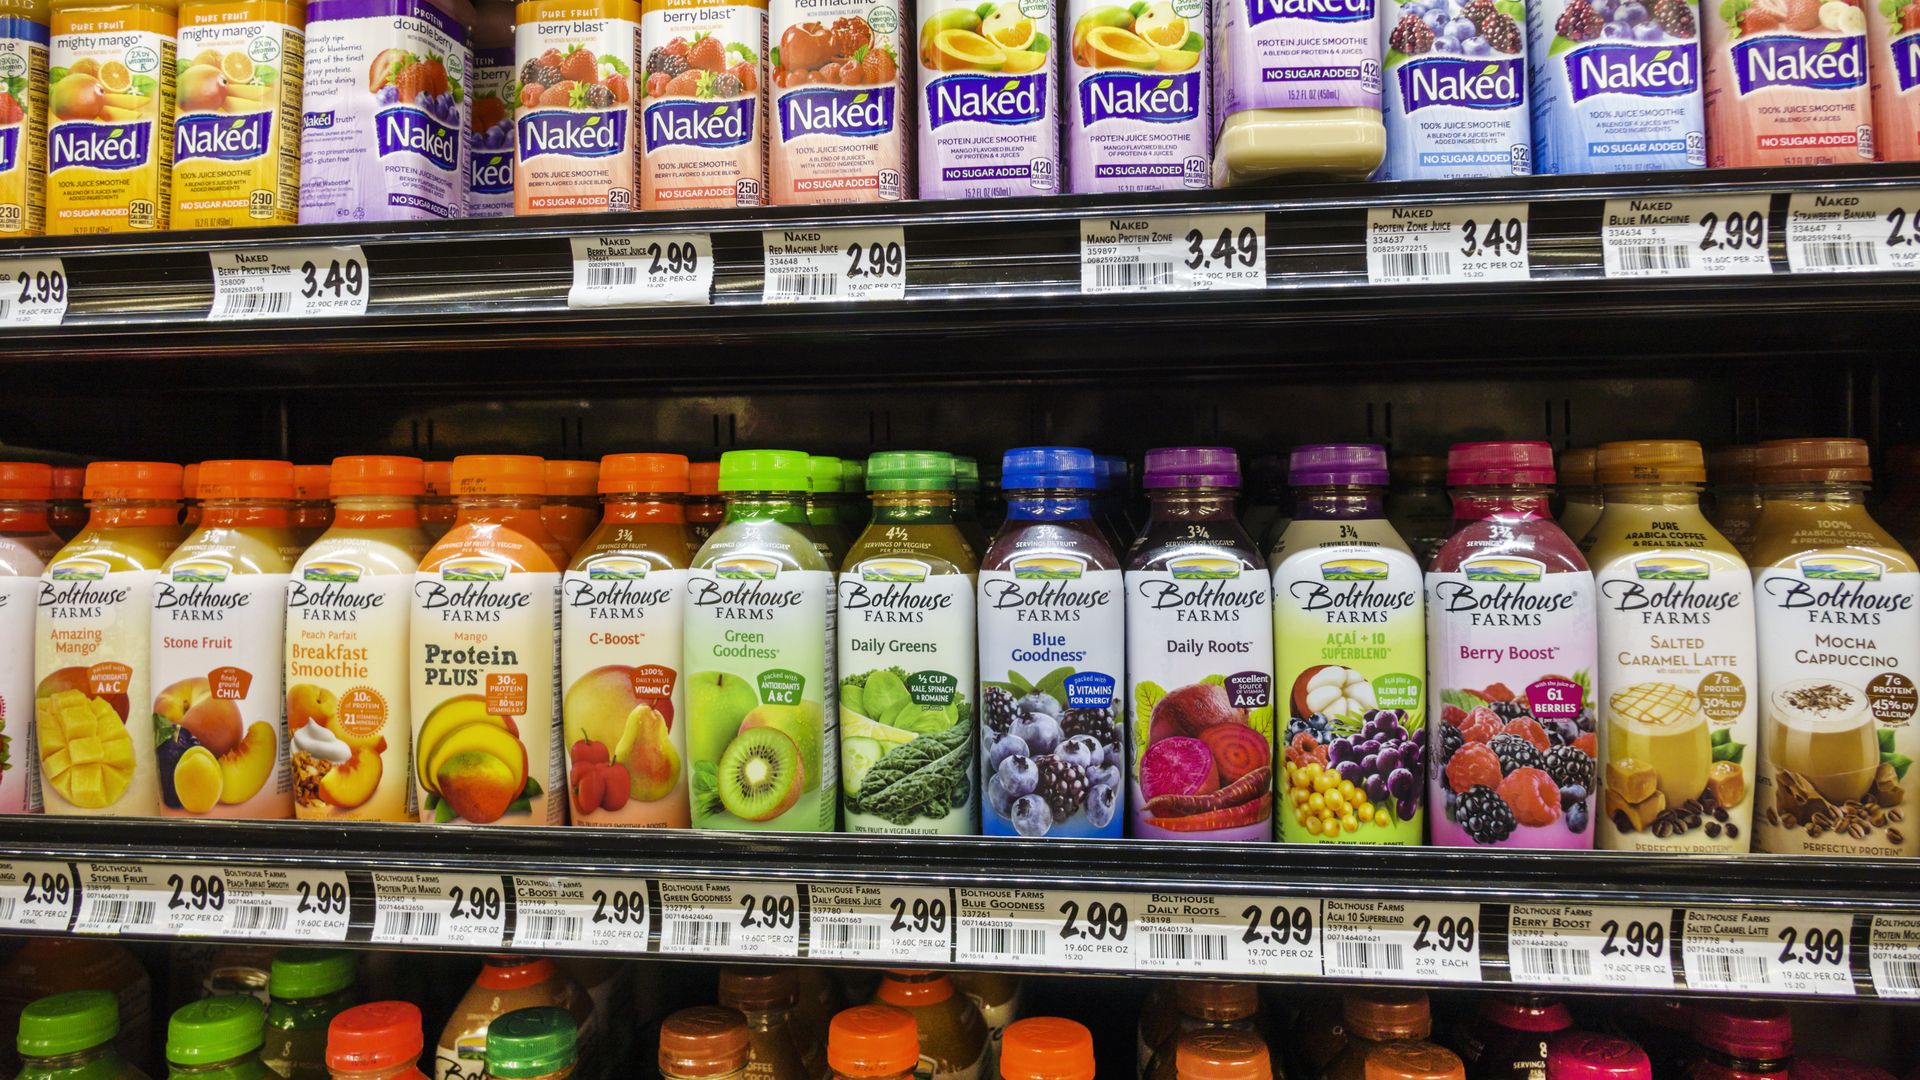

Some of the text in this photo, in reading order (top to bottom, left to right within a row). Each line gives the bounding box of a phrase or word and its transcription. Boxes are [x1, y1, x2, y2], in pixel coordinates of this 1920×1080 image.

[663, 7, 731, 23] berry blast
[182, 26, 217, 41] mighty
[538, 21, 604, 36] berry blast
[1322, 37, 1368, 46] SMOOTHIE
[1284, 71, 1320, 79] SUGAR
[1322, 70, 1360, 78] ADDED
[1032, 161, 1051, 175] 420
[880, 173, 899, 186] 320
[738, 182, 758, 195] 250
[251, 193, 272, 206] 290
[1630, 201, 1672, 211] NAKED
[1815, 196, 1859, 207] NAKED
[59, 208, 128, 219] NO SUGAR ADDED
[131, 202, 153, 215] 290
[1392, 208, 1433, 218] NAKED
[1844, 210, 1876, 220] BANANA
[1110, 220, 1149, 230] NAKED
[1609, 214, 1690, 226] BLUE MACHINE
[1373, 221, 1451, 233] PROTEIN ZONE JUICE
[1700, 211, 1763, 250] 2.99
[600, 238, 630, 246] NAKED
[784, 232, 820, 241] NAKED
[1086, 232, 1173, 243] MANGO PROTEIN ZONE
[1461, 218, 1522, 257] 3.49
[769, 244, 838, 255] RED MACHINE JUICE
[1087, 247, 1117, 255] 359897
[1184, 227, 1258, 270] 3.49
[235, 254, 268, 263] NAKED
[648, 242, 697, 275] 2.99
[846, 242, 900, 277] 2.99
[301, 259, 362, 299] 3.49
[18, 271, 65, 304] 2.99
[1652, 522, 1679, 530] PURE
[172, 609, 223, 621] FARMS
[303, 609, 357, 621] FARMS
[590, 607, 644, 619] FARMS
[864, 610, 923, 623] FARMS
[1177, 610, 1239, 622] FARMS
[1808, 611, 1881, 625] FARMS
[1472, 614, 1542, 626] FARMS
[51, 629, 102, 643] Amazing
[301, 630, 357, 641] Peach Parfait
[455, 632, 488, 642] Mango
[589, 633, 640, 645] C-Boost
[725, 630, 764, 643] Green
[1033, 633, 1066, 646] Blue
[1371, 633, 1385, 644] 10
[1650, 635, 1704, 649] SALTED
[1815, 634, 1876, 649] MOCHA
[56, 642, 97, 656] Mango
[164, 637, 232, 649] Stone Fruit
[852, 639, 937, 655] Daily Greens
[1167, 640, 1249, 656] Daily Roots
[293, 644, 368, 661] Breakfast
[425, 644, 518, 665] Protein
[713, 645, 777, 659] Goodness
[1012, 649, 1083, 662] Goodness
[1322, 648, 1387, 659] SUPERBLEND
[1460, 646, 1555, 663] Berry Boost
[1618, 652, 1737, 666] CARAMEL LATTE
[1795, 650, 1898, 668] CAPPUCCINO
[291, 661, 368, 678] Smoothie
[425, 668, 478, 686] PLUS
[930, 674, 947, 684] CUP
[1231, 675, 1268, 683] excellent
[216, 689, 241, 699] CHIA
[1076, 685, 1112, 695] VITAMINS
[1547, 688, 1564, 700] 61
[1085, 697, 1110, 705] ENERGY
[1535, 703, 1576, 713] BERRIES
[1804, 843, 1900, 856] PERFECTLY PROTEIN
[91, 874, 149, 884] STONE FRUIT
[22, 872, 70, 904] 2.99
[167, 874, 225, 911] 2.99
[518, 888, 584, 898] C-BOOST JUICE
[961, 889, 1044, 899] BOLTHOUSE FARMS
[297, 881, 346, 915] 2.99
[449, 886, 501, 920] 2.99
[664, 893, 732, 903] GREEN GOODNESS
[961, 899, 1045, 910] BLUE GOODNESS
[592, 890, 645, 924] 2.99
[740, 894, 794, 929] 2.99
[1147, 904, 1220, 915] DAILY ROOTS
[890, 897, 946, 933] 2.99
[1059, 900, 1129, 941] 2.99
[1327, 913, 1404, 923] ACAI 10 SUPERBLEND
[1242, 905, 1312, 945] 2.99
[1513, 917, 1591, 928] BERRY BOOST
[1687, 923, 1768, 935] SALTED CARAMEL LATTE
[1413, 915, 1474, 952] 2.99
[1600, 920, 1664, 957] 2.99
[1065, 944, 1094, 952] 19.60C
[1778, 926, 1844, 965] 2.99
[1513, 1061, 1546, 1069] SERVINGS
